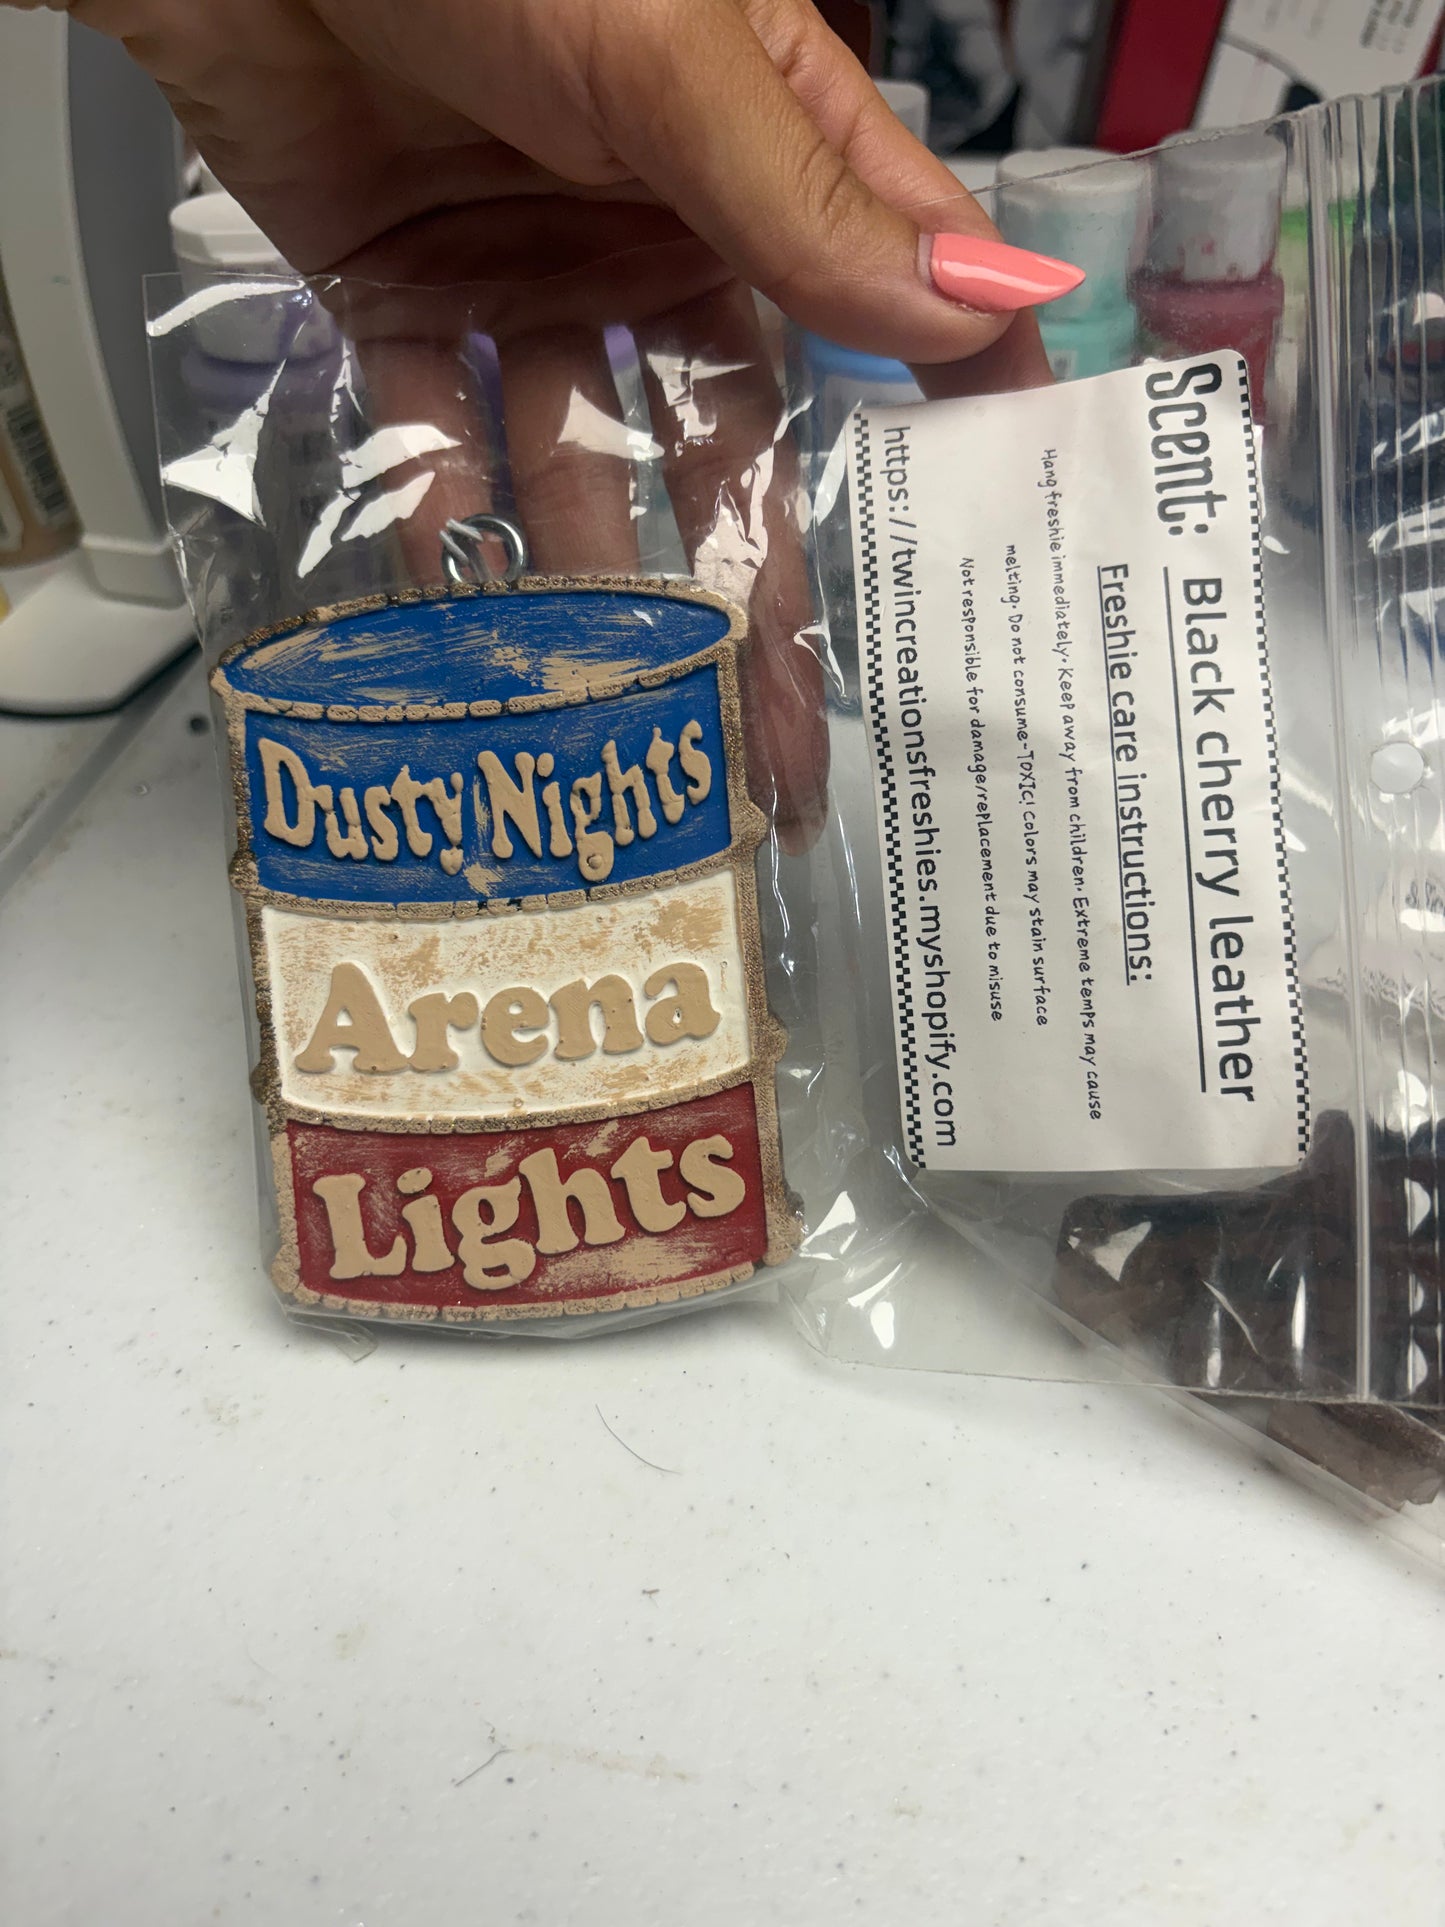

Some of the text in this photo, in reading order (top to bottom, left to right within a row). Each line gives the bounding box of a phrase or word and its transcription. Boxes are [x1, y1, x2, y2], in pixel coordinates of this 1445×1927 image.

[1001, 545, 1022, 608] melting.
[1008, 614, 1023, 632] Do
[1012, 638, 1026, 664] not
[880, 426, 956, 1147] https://twincreationsfreshies.myshopify.com
[960, 558, 1003, 1021] Not responsible for damage/replacement due to misuse
[1038, 449, 1101, 1119] Hang freshie immediately. Keep away from children. Extreme temps may cause
[1101, 563, 1155, 980] Freshie care instructions:
[1144, 362, 1261, 1102] Scent: Black cherry leather
[259, 720, 712, 881] Dusty Nights
[1023, 870, 1040, 903] may
[1029, 907, 1046, 952] stain
[297, 963, 721, 1073] Arena
[1033, 957, 1051, 1026] surface
[314, 1135, 745, 1290] Lights
